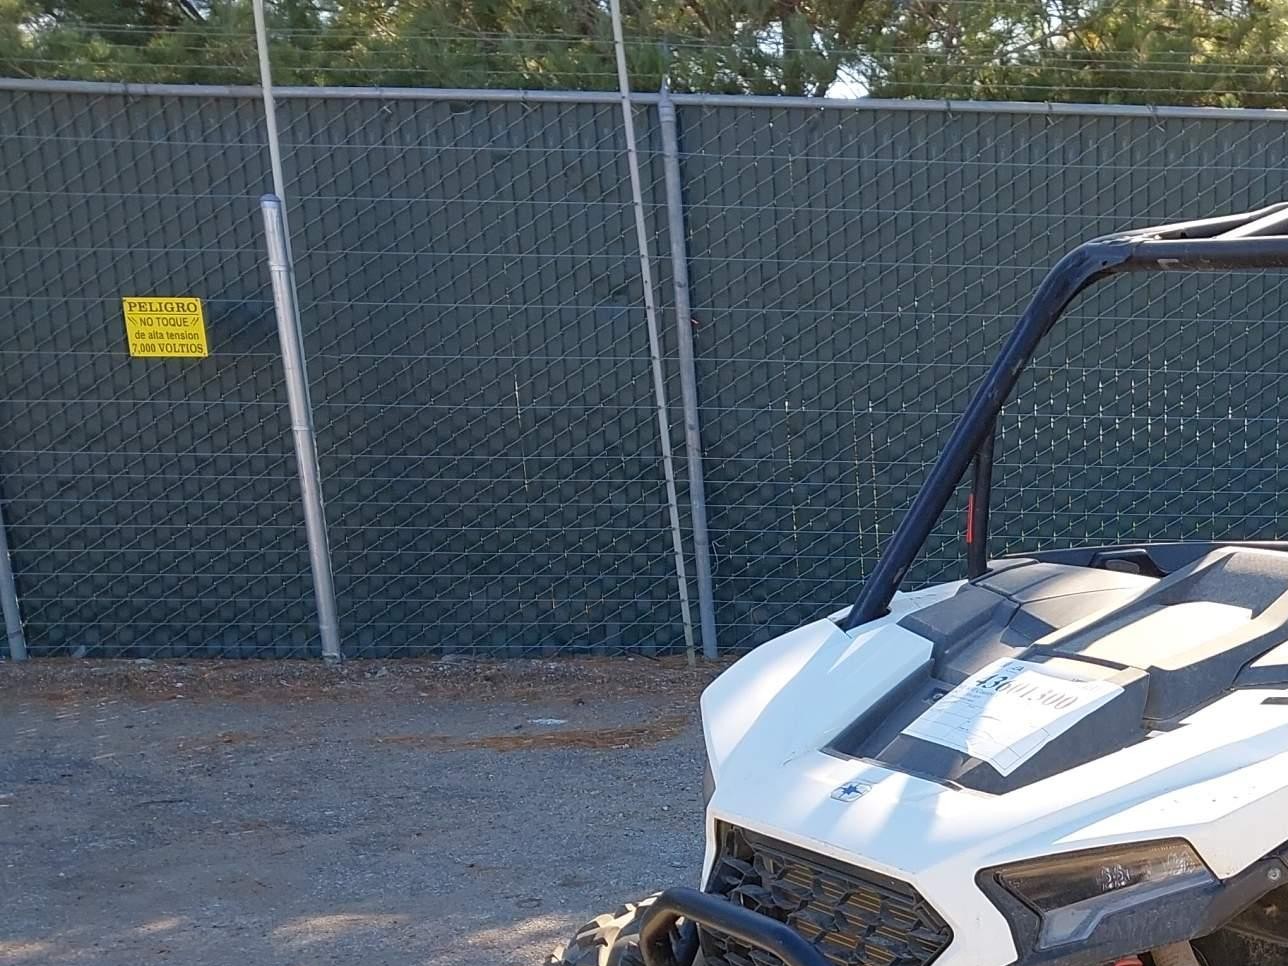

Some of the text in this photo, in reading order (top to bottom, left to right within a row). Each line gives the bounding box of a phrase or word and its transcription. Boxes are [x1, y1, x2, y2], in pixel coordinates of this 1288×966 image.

[127, 301, 198, 313] PELIGRO
[140, 317, 190, 327] NO TOQUE
[134, 330, 146, 340] de
[148, 330, 165, 340] alta
[158, 343, 204, 354] VOLTIOS
